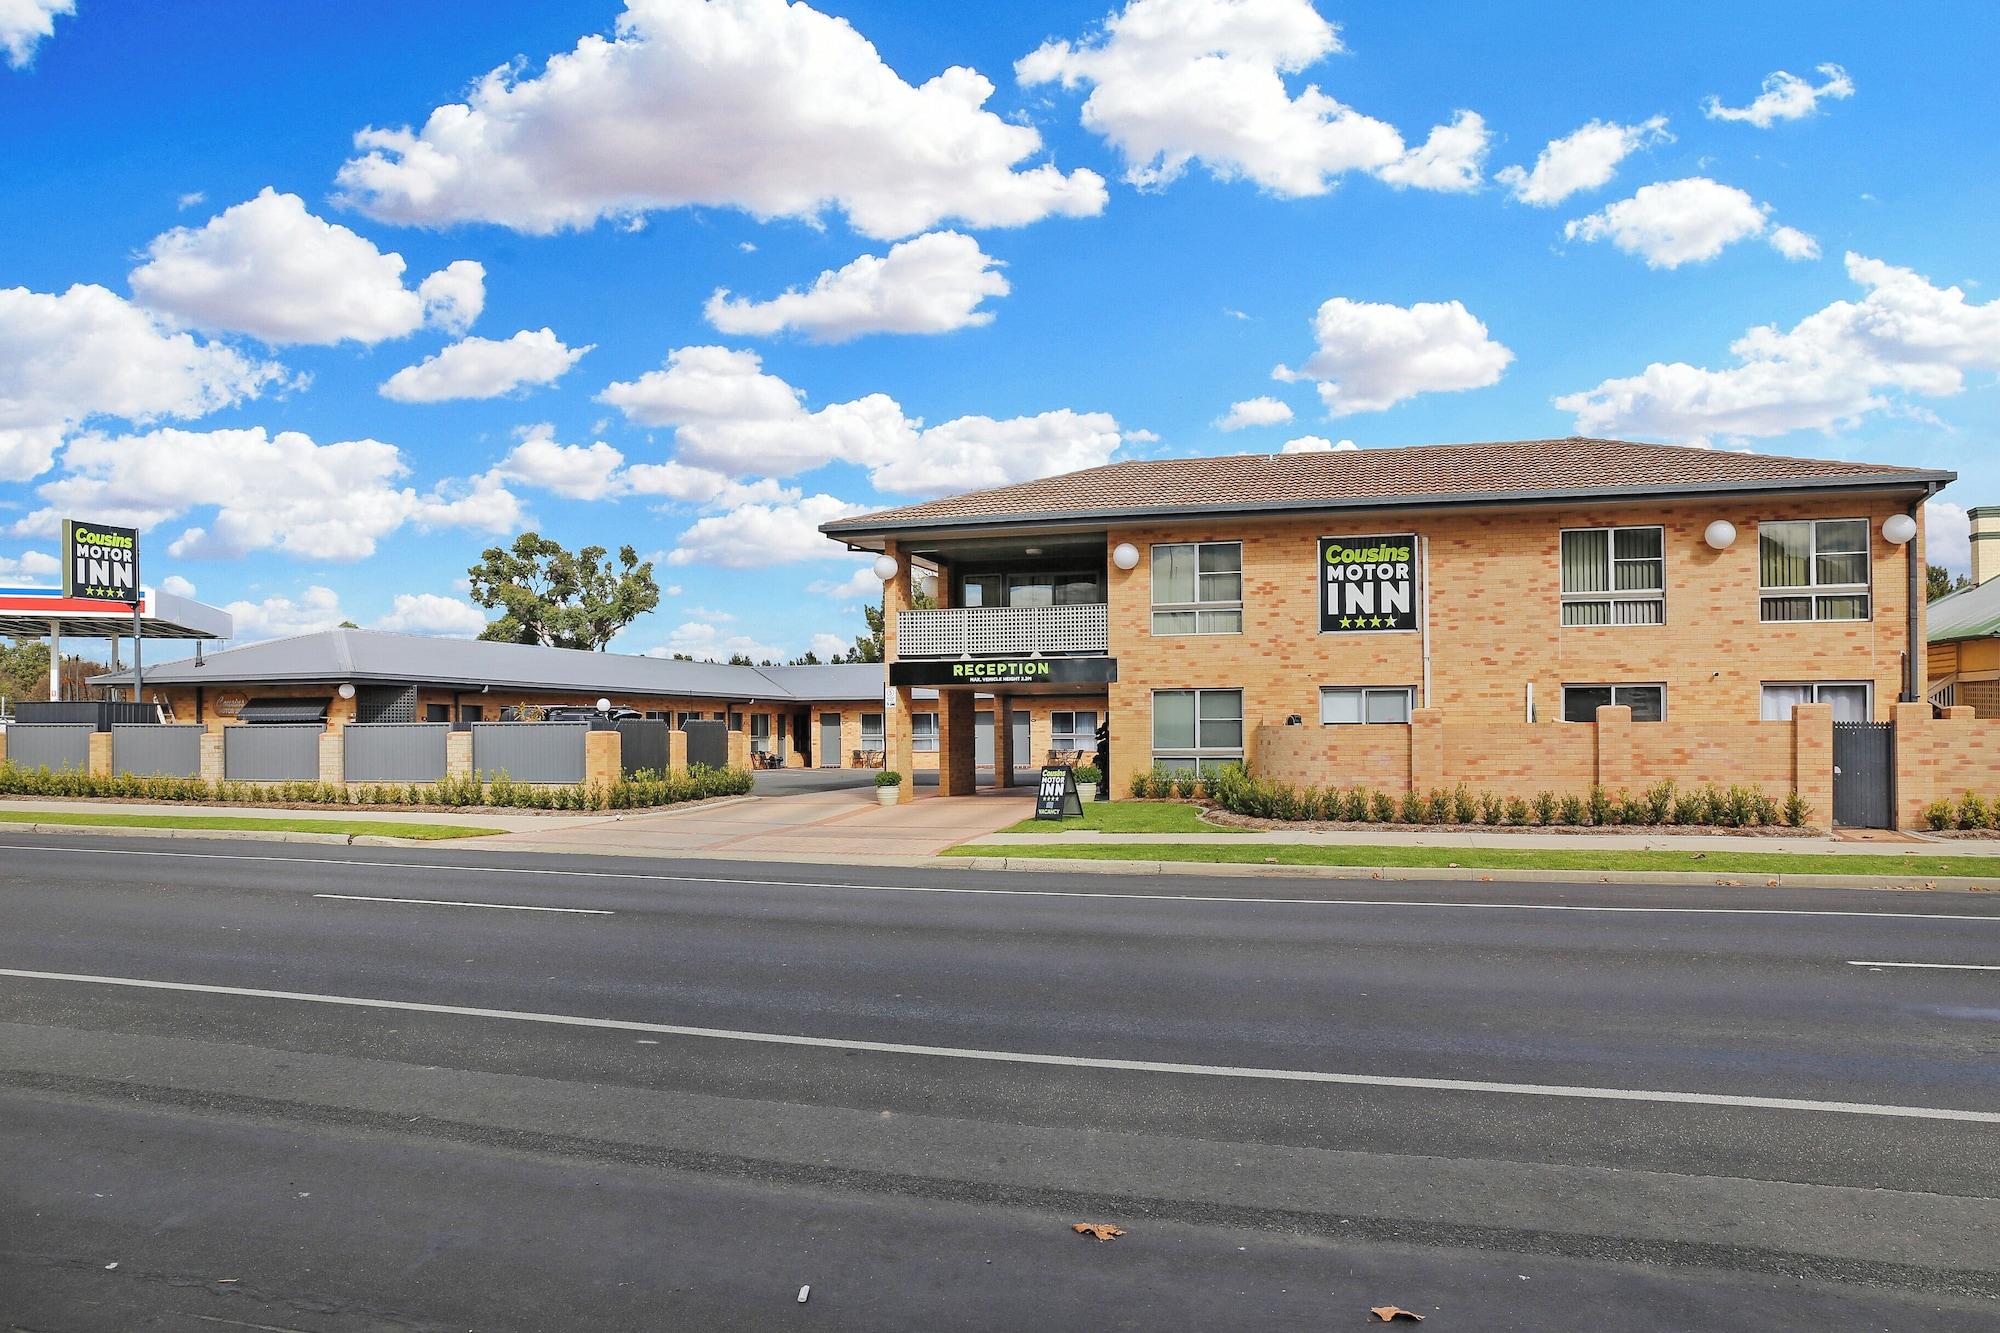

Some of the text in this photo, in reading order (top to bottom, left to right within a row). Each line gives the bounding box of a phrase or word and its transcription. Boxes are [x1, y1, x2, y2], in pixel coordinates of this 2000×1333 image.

[76, 528, 133, 549] Cousins
[77, 544, 132, 562] MOTOR
[1326, 544, 1410, 564] Cousins
[77, 558, 133, 588] INN
[1327, 563, 1409, 581] MOTOR
[1327, 581, 1410, 615] INN
[953, 663, 1049, 676] RECEPTION
[1042, 769, 1066, 777] Cousins
[1040, 783, 1065, 796] INN
